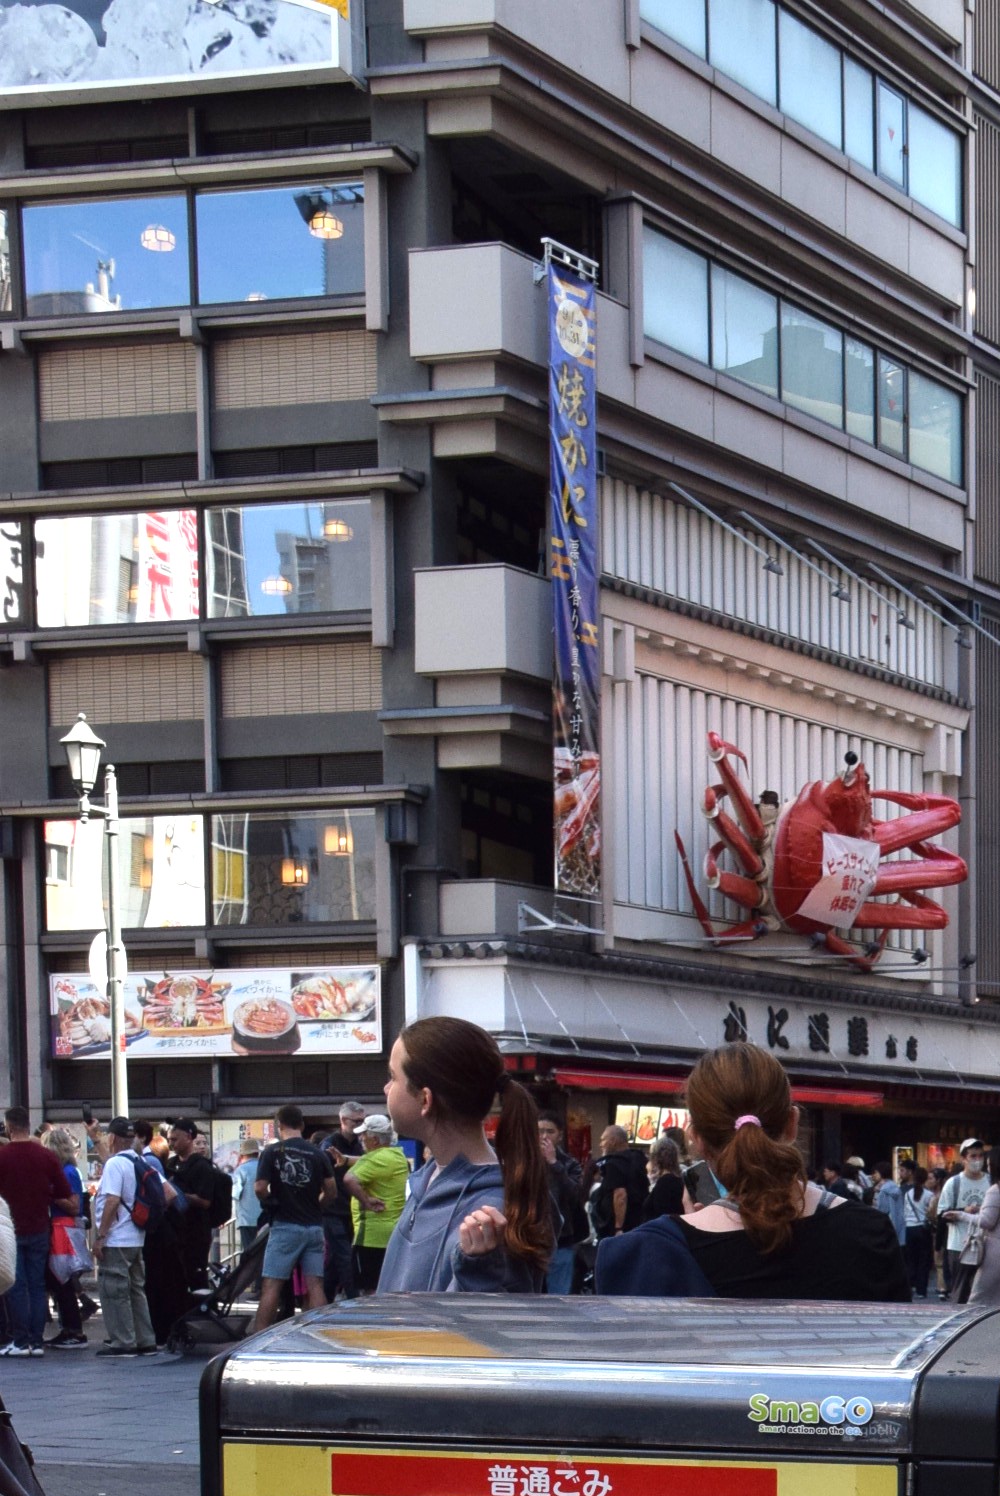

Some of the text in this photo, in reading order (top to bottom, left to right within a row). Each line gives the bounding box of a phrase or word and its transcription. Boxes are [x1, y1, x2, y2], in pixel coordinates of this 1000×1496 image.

[748, 1393, 873, 1426] SmaGO
[758, 1424, 786, 1433] Smart
[787, 1424, 815, 1435] action
[816, 1427, 828, 1435] on
[829, 1425, 844, 1435] the
